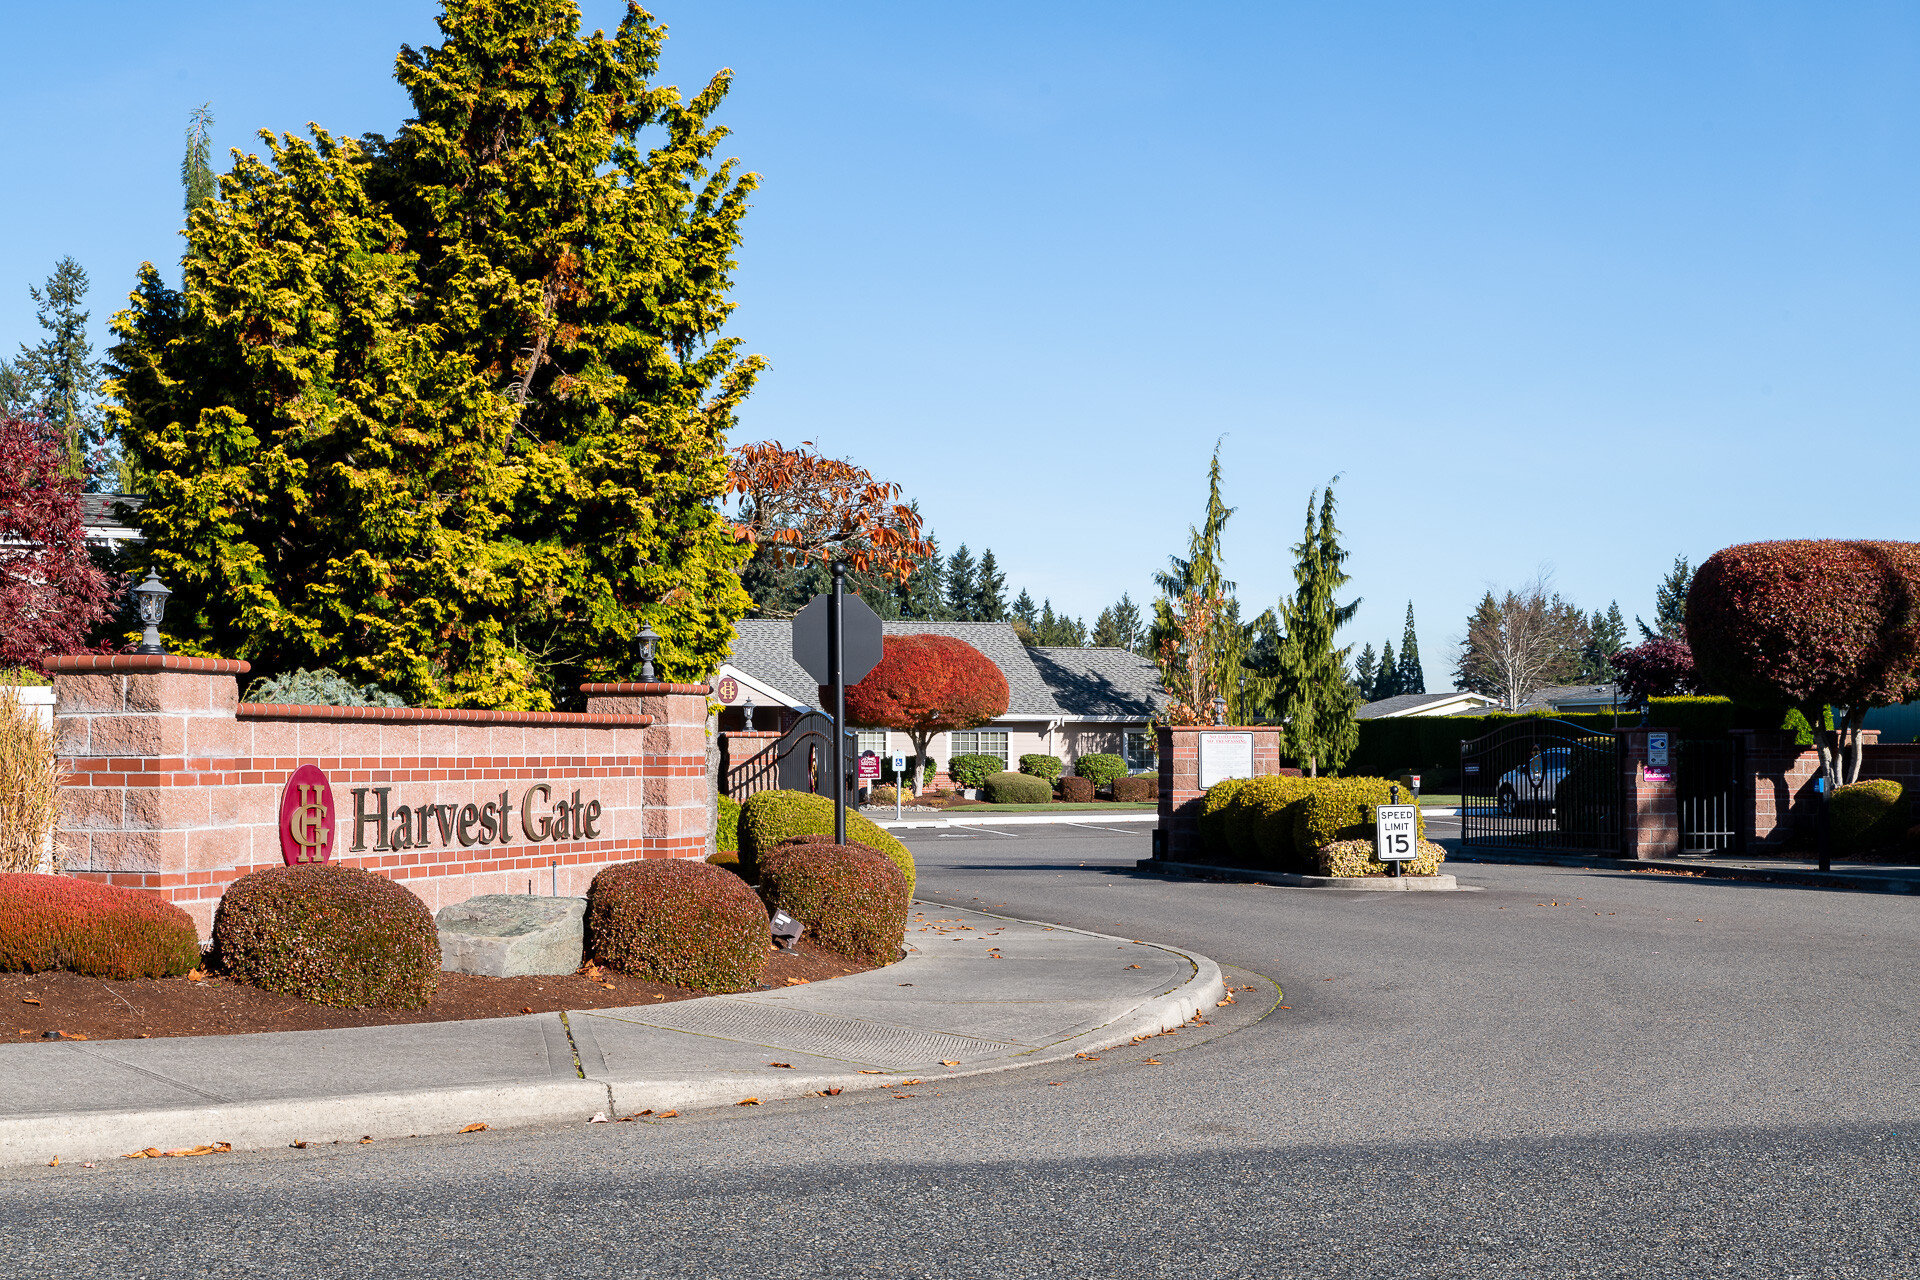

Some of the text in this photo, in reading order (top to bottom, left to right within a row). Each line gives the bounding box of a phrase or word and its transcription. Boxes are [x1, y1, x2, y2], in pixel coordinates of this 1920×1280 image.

[349, 783, 601, 853] Harvest Gate
[1381, 811, 1413, 820] SPEED
[1385, 822, 1410, 831] LIMIT
[1386, 834, 1410, 854] 15
